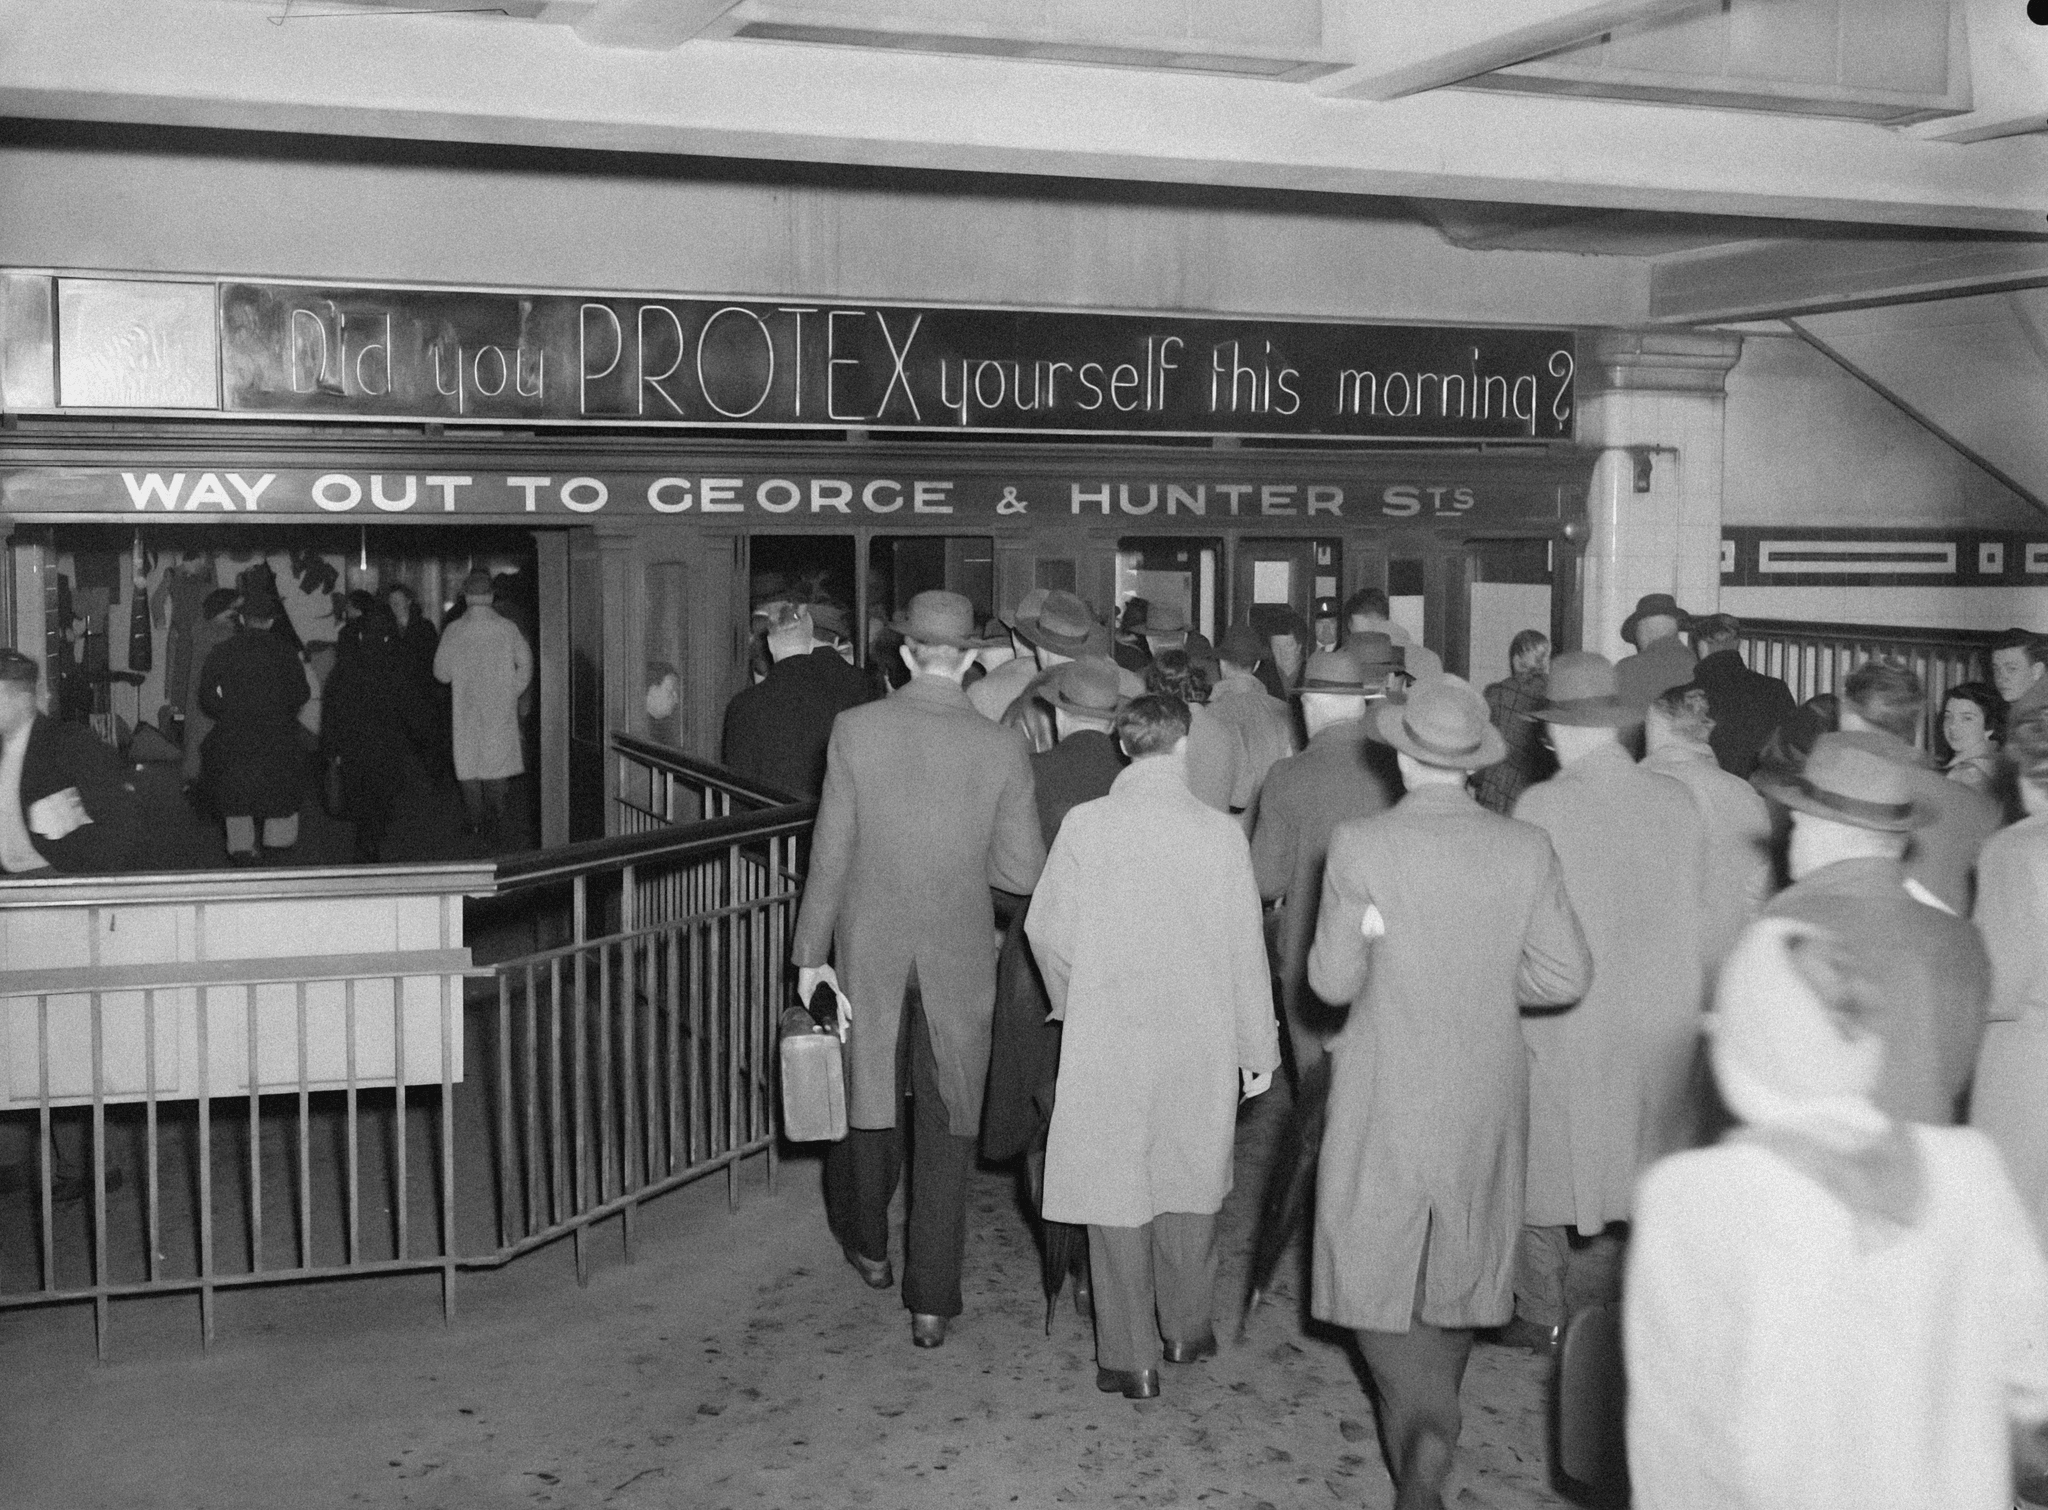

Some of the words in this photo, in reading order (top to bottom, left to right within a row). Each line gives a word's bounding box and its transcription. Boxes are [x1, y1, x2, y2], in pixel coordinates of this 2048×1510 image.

[430, 343, 545, 415] you
[579, 303, 924, 421] PROTEX
[940, 336, 1185, 426] yourself
[1210, 340, 1302, 416] this
[1336, 348, 1576, 436] morning?
[120, 472, 278, 512] WAY
[311, 473, 473, 513] OUT
[506, 475, 609, 513] TO
[646, 476, 955, 515] GEORGE
[995, 486, 1029, 516] &
[1070, 482, 1346, 517] HUNTER
